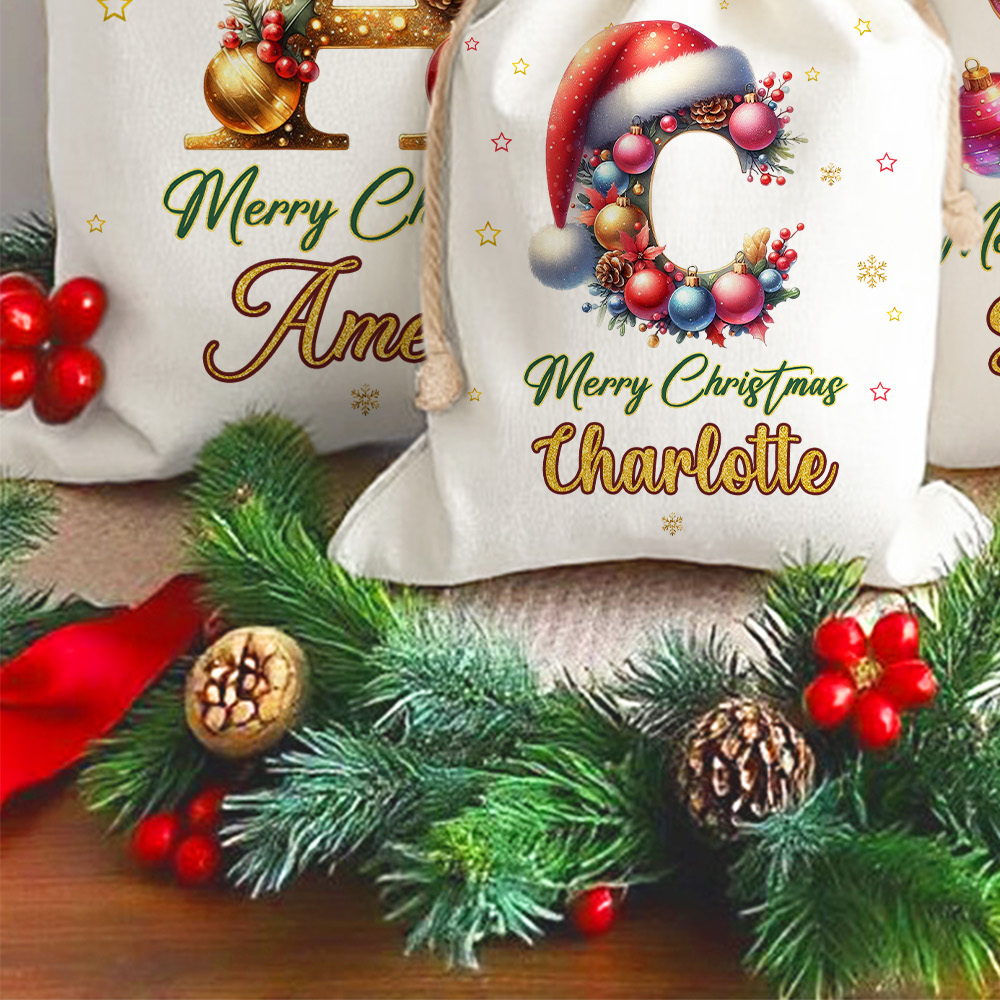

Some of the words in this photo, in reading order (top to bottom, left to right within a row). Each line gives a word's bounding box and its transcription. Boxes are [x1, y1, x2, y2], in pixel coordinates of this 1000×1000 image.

[162, 164, 339, 252] Merry
[523, 351, 654, 416] Merry
[660, 352, 849, 416] Christmas
[531, 421, 840, 496] Charlotte
